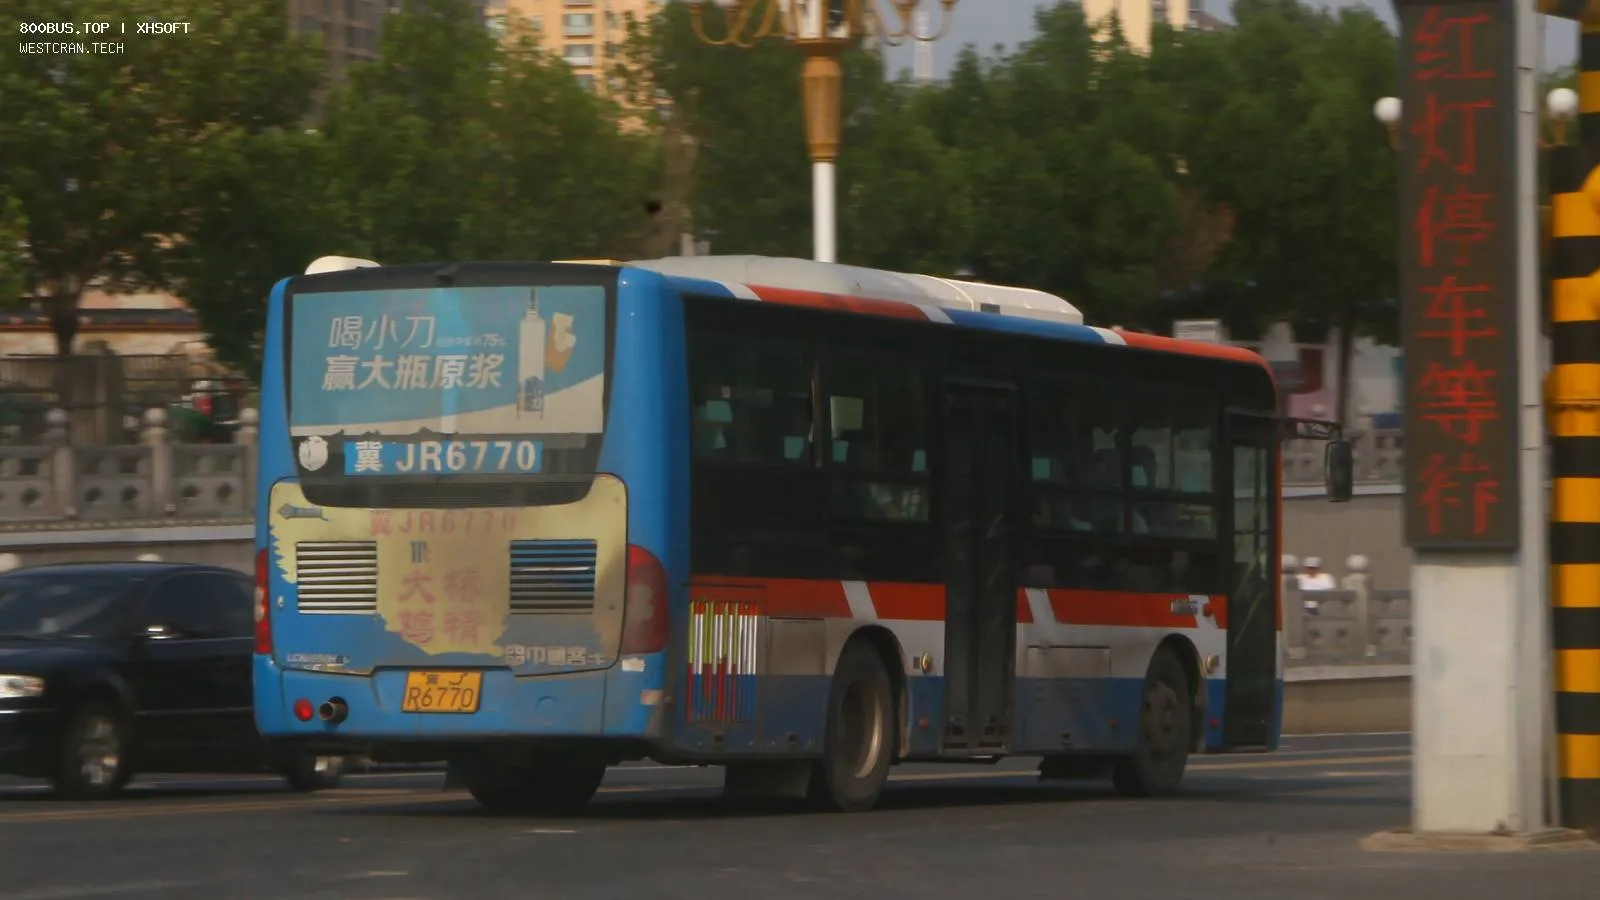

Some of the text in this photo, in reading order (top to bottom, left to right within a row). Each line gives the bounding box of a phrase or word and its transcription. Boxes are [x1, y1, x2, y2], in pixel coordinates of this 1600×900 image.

[328, 314, 435, 350] 喝小刀
[321, 354, 504, 391] 赢大瓶原浆
[354, 440, 536, 472] 冀 JR6770
[406, 686, 475, 710] R6770
